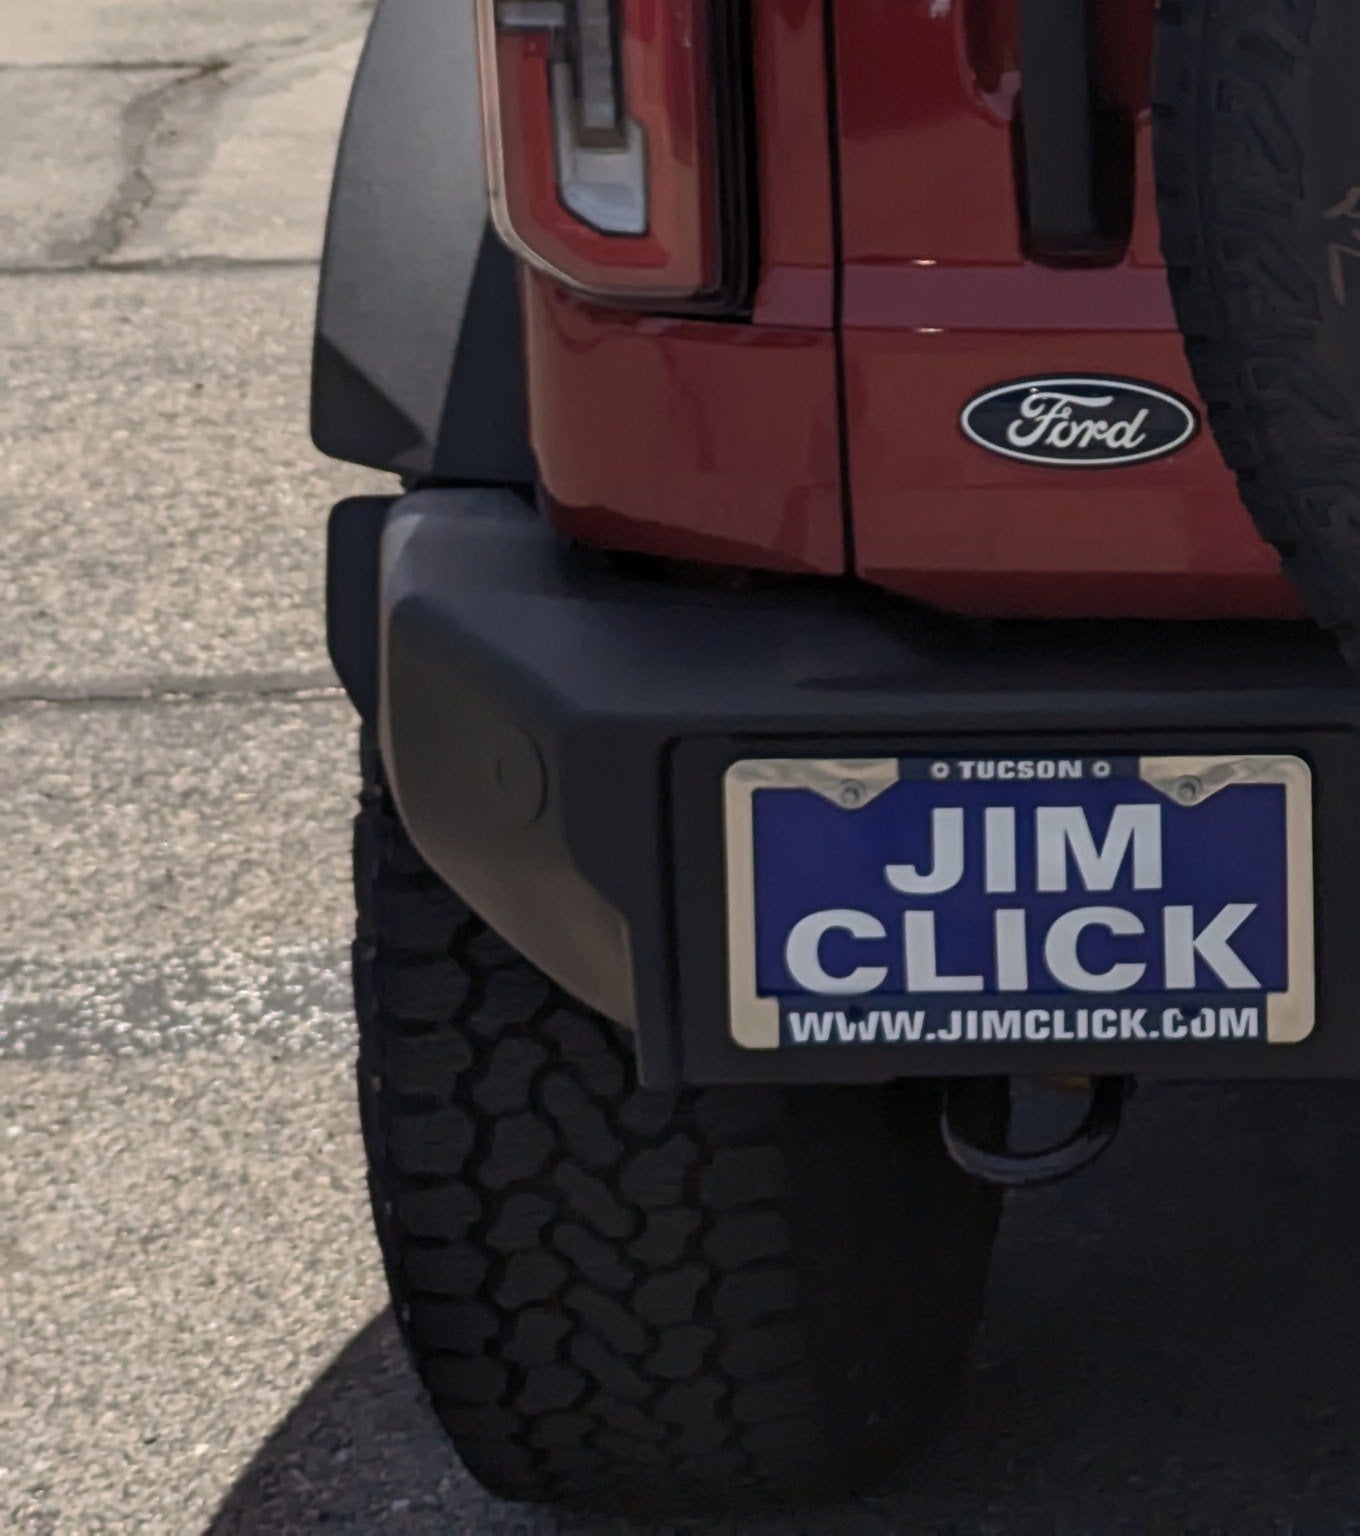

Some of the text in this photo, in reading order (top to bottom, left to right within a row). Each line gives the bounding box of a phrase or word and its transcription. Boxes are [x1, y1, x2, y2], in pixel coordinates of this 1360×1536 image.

[1007, 387, 1150, 450] Ford
[956, 759, 1084, 781] TUCSON
[884, 802, 1163, 896] JIM
[784, 901, 1262, 996] CLICK
[788, 1006, 1260, 1044] WWW.JIMCLICK.COM
